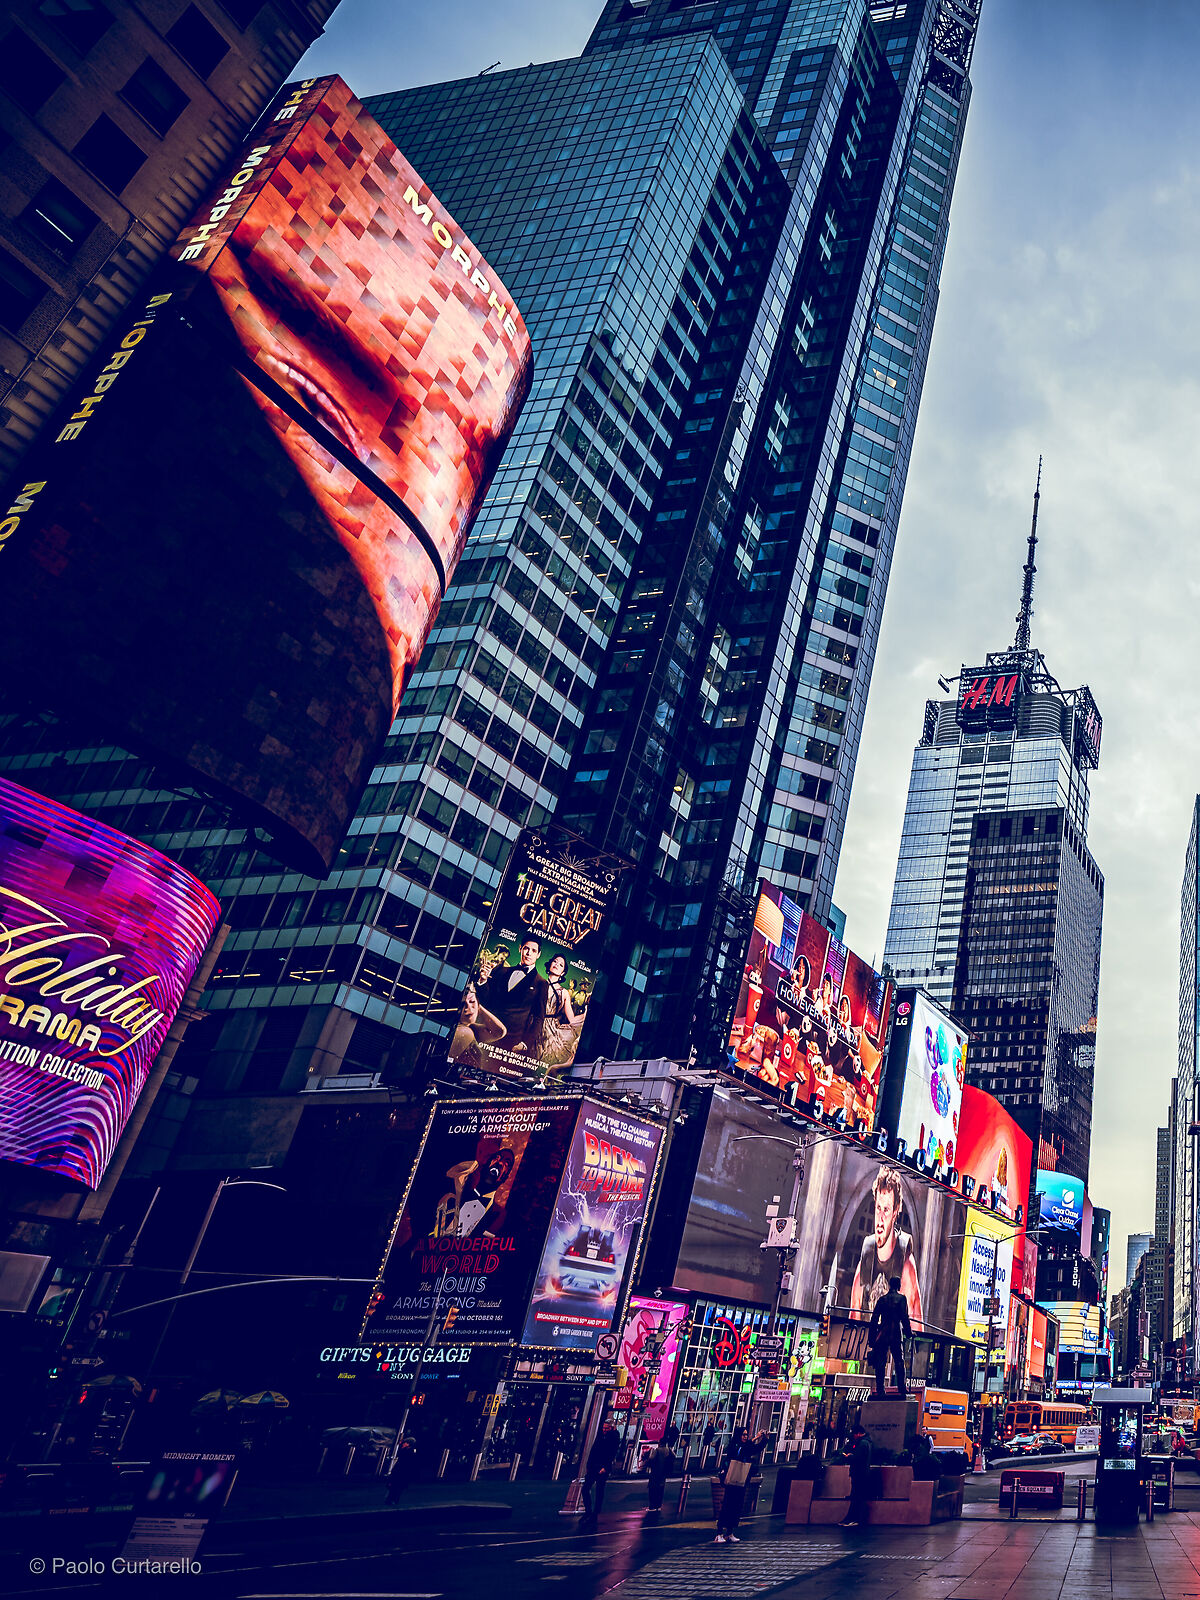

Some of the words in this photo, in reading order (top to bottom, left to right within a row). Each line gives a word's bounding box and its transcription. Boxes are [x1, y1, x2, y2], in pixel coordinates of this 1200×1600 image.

[177, 145, 271, 263] MORPHE
[402, 185, 518, 340] MORPHE
[960, 675, 1018, 709] H&M
[542, 866, 594, 896] EXTRAVAGANZA
[560, 866, 572, 877] BIG
[572, 873, 609, 895] BROADWAY
[516, 878, 549, 905] THE
[549, 893, 604, 931] GREAT
[519, 902, 591, 944] GATSBY
[533, 929, 548, 939] NEW
[547, 934, 574, 950] MUSICAL
[780, 984, 820, 1020] HOWEVER
[821, 1015, 836, 1030] YOU
[896, 1017, 908, 1026] LG
[496, 1047, 526, 1060] BROADWAY
[526, 1056, 550, 1069] THEATRE
[508, 1057, 539, 1071] BROADWAY
[40, 1053, 105, 1091] COLLECTION
[480, 1113, 537, 1124] KNOCKOUT
[606, 1116, 620, 1128] TIME
[620, 1120, 627, 1131] TO
[627, 1124, 650, 1139] CHANGE
[448, 1125, 478, 1134] LOUIS
[585, 1118, 609, 1133] MUSICAL
[609, 1126, 633, 1142] THEATER
[633, 1135, 656, 1149] HISTORY
[583, 1130, 640, 1175] BACK
[582, 1165, 598, 1181] TO
[593, 1169, 645, 1192] FUTURE
[618, 1193, 641, 1201] MUSICAL
[1052, 1206, 1065, 1215] Clear
[429, 1236, 516, 1252] WONDERFUL
[973, 1240, 994, 1260] Access
[421, 1254, 500, 1274] WORLD
[419, 1281, 432, 1292] The
[433, 1276, 488, 1293] LOUIS
[393, 1296, 476, 1309] ARMSTRONG
[968, 1298, 981, 1313] with
[536, 1313, 560, 1321] BROADWAY
[319, 1347, 373, 1363] GIFTS
[385, 1347, 472, 1363] LUGGAGE
[389, 1363, 405, 1372] NY
[645, 1423, 663, 1431] BOX
[162, 1451, 200, 1461] MIDNIGHT
